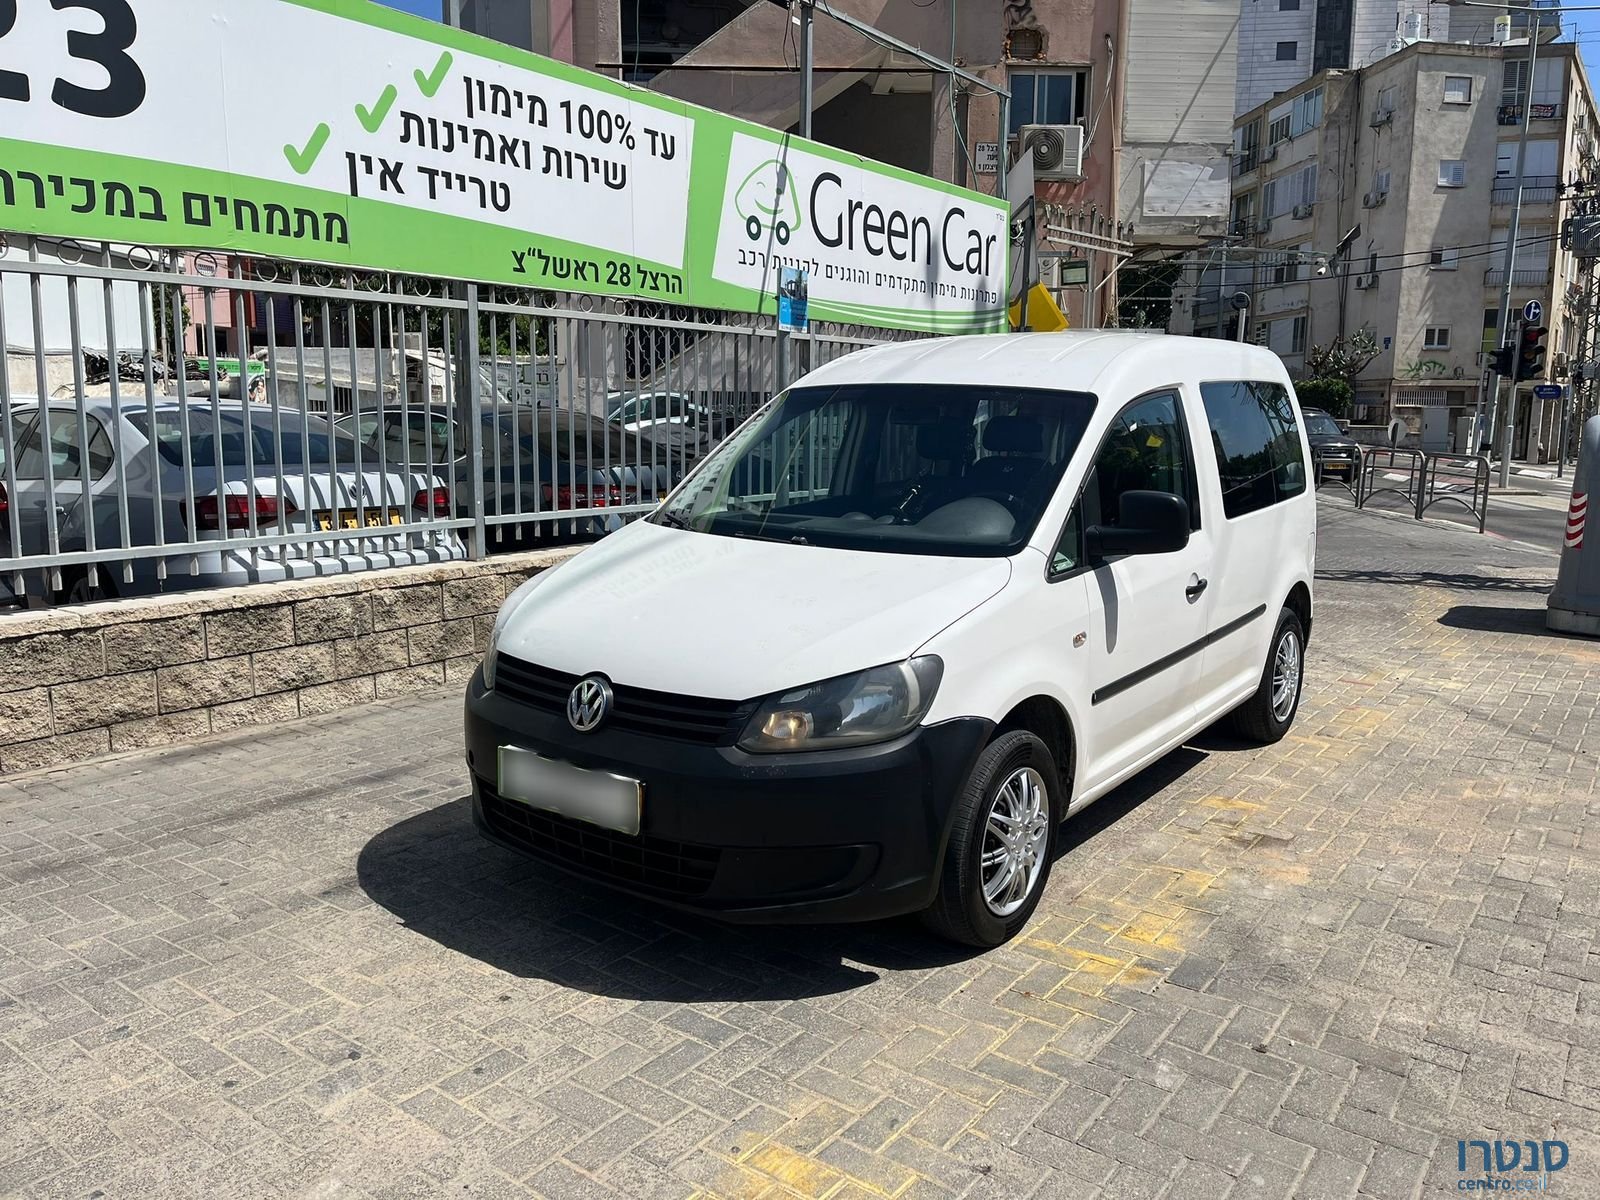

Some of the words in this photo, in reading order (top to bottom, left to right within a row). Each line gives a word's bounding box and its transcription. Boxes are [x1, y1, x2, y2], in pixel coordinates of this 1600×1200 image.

[463, 75, 548, 128] מימון
[399, 110, 531, 171] ואמינות
[559, 100, 636, 151] 100%
[643, 127, 676, 161] עד
[345, 151, 405, 197] אין
[541, 145, 627, 190] שירות
[417, 165, 511, 212] טרייד
[182, 191, 349, 245] מתמחים
[809, 172, 932, 266] Green
[941, 206, 997, 277] Car
[605, 260, 631, 287] 28
[738, 248, 766, 269] רכב
[825, 264, 870, 285] והוגנים
[636, 263, 683, 295] הרצל
[875, 273, 926, 294] מתקדמים
[931, 281, 957, 299] מימון
[960, 286, 997, 304] פתרונות
